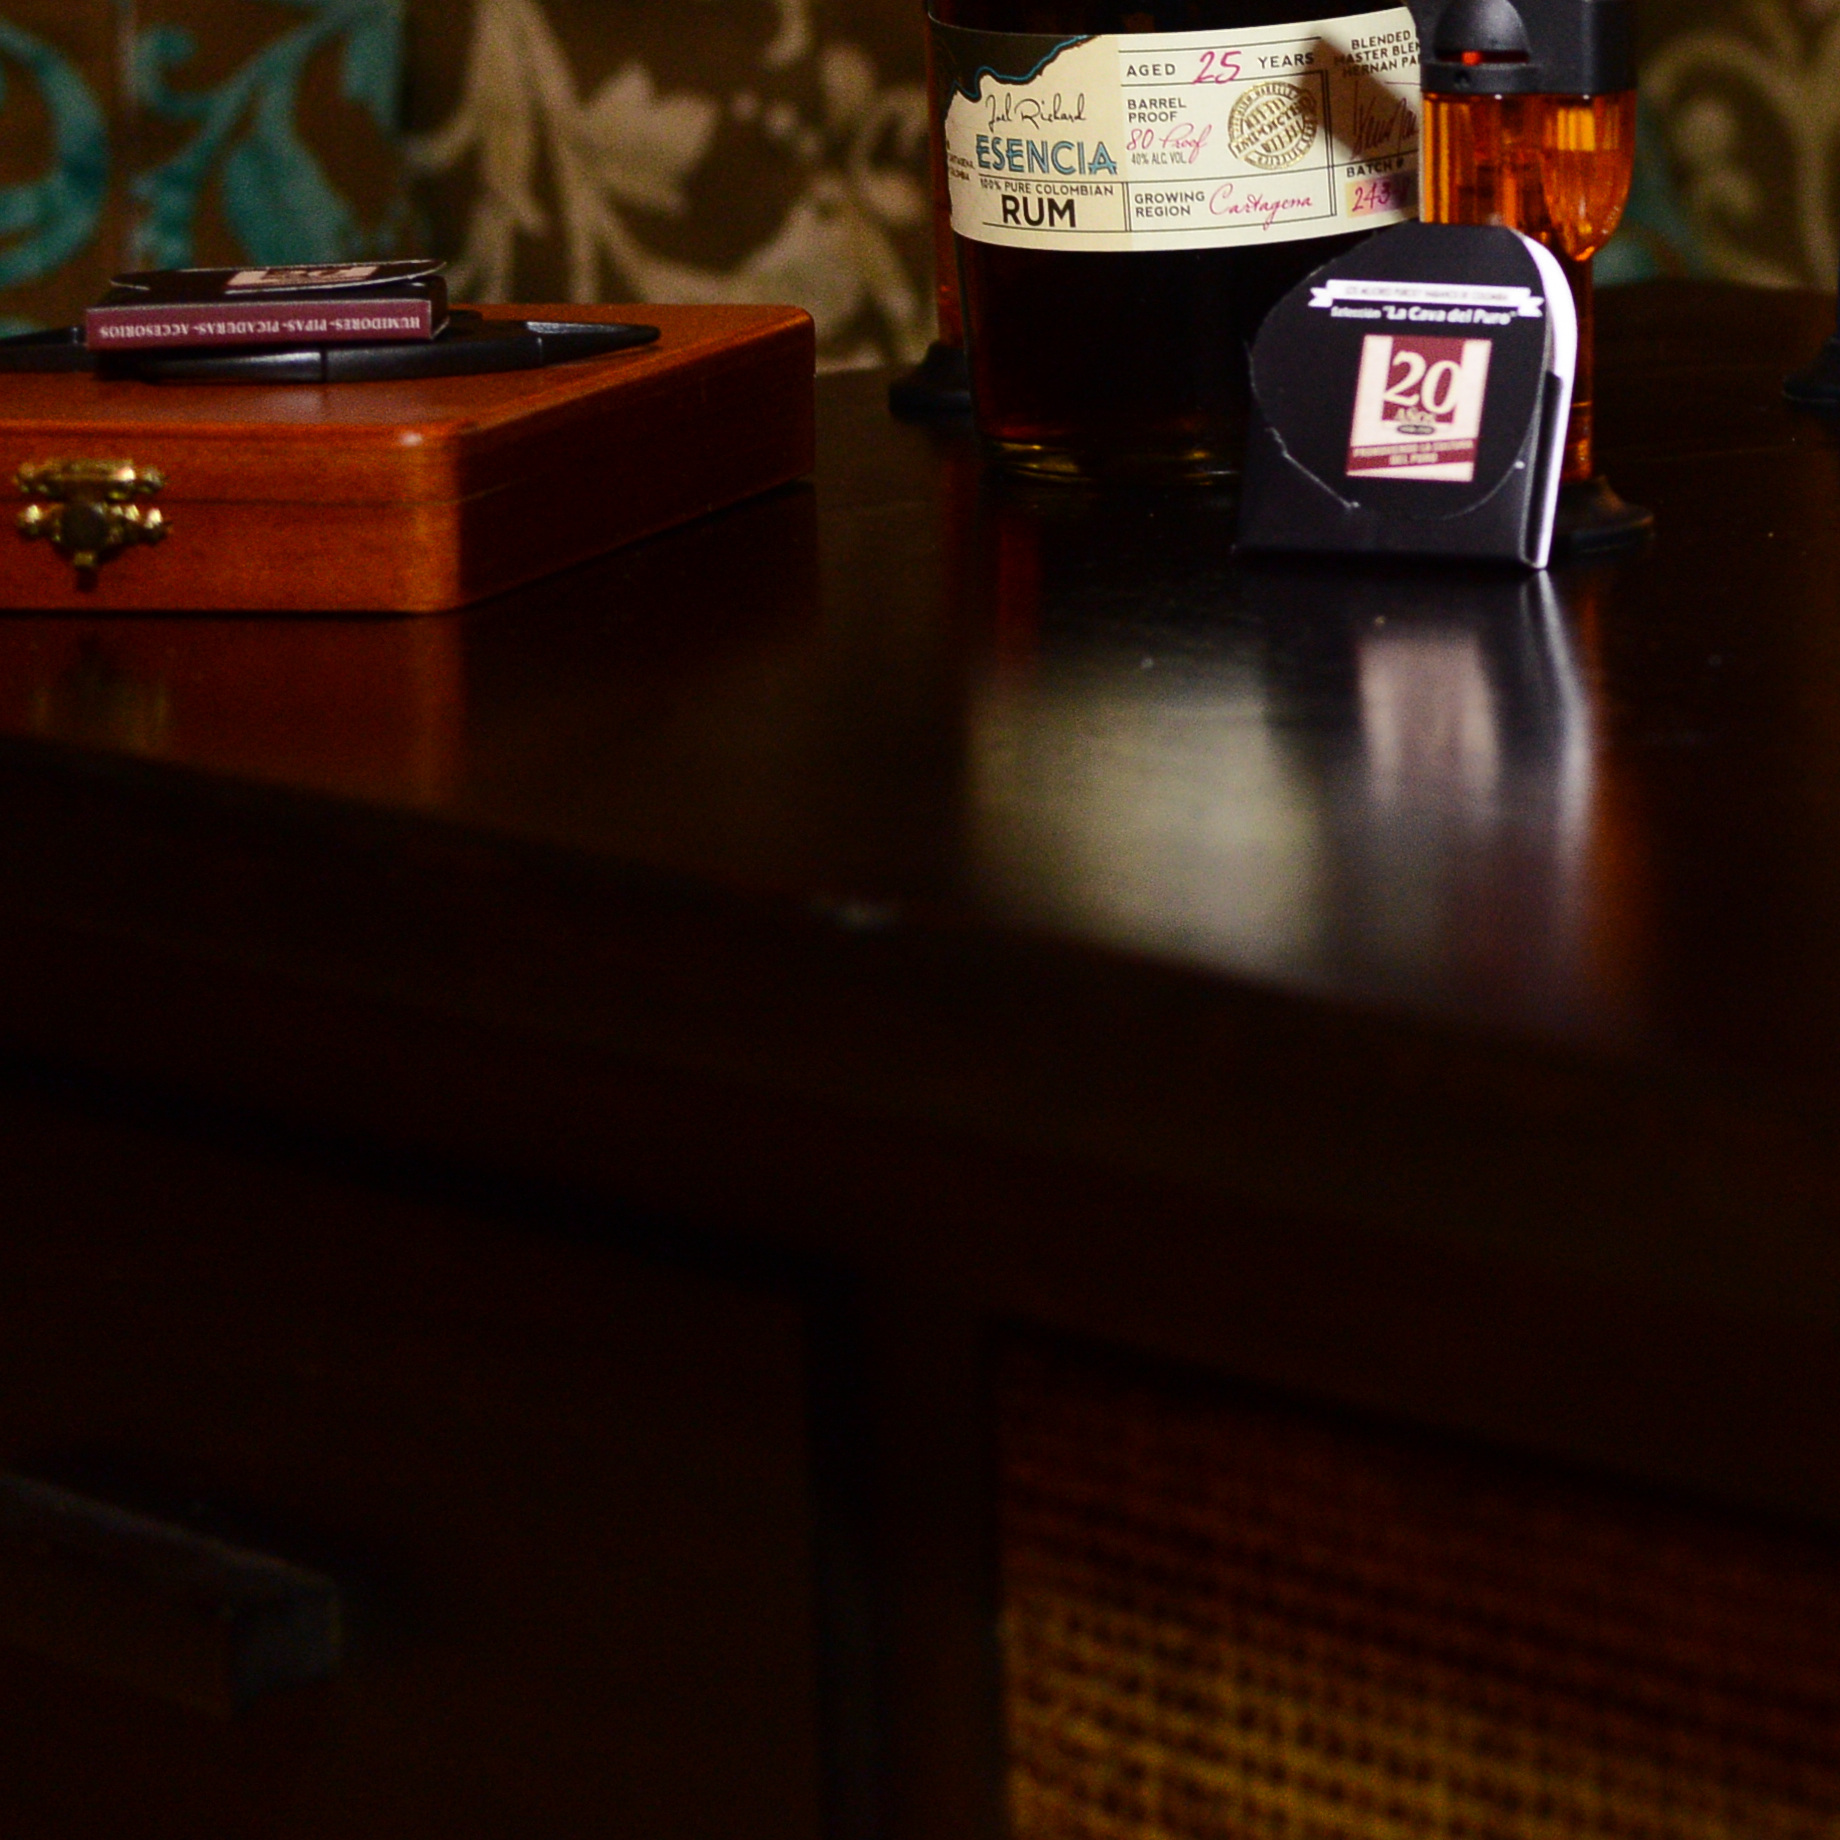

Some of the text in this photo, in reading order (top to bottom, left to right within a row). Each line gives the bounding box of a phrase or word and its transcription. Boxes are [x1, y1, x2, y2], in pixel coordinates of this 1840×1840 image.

[1351, 30, 1411, 50] BLENDED
[1334, 42, 1420, 66] MASTER BLEN
[1126, 51, 1315, 85] AGED 25 YEARS
[1343, 61, 1397, 78] HERNAN
[1014, 92, 1087, 130] Richard
[1127, 98, 1187, 109] BARREL
[1128, 111, 1178, 123] PROOF
[1126, 123, 1212, 164] 80 Proof
[976, 134, 1118, 175] ESENCIA
[1346, 160, 1392, 178] BATCH
[1004, 181, 1032, 194] PURE
[1035, 182, 1114, 196] COLOMBIAN
[1001, 194, 1077, 228] RUM
[1134, 182, 1313, 231] GROWING Cartagena
[1135, 205, 1192, 218] REGION
[1408, 306, 1445, 321] Cava
[1447, 308, 1472, 323] del
[100, 323, 189, 339] ACCESORIOS
[1382, 350, 1462, 415] 20
